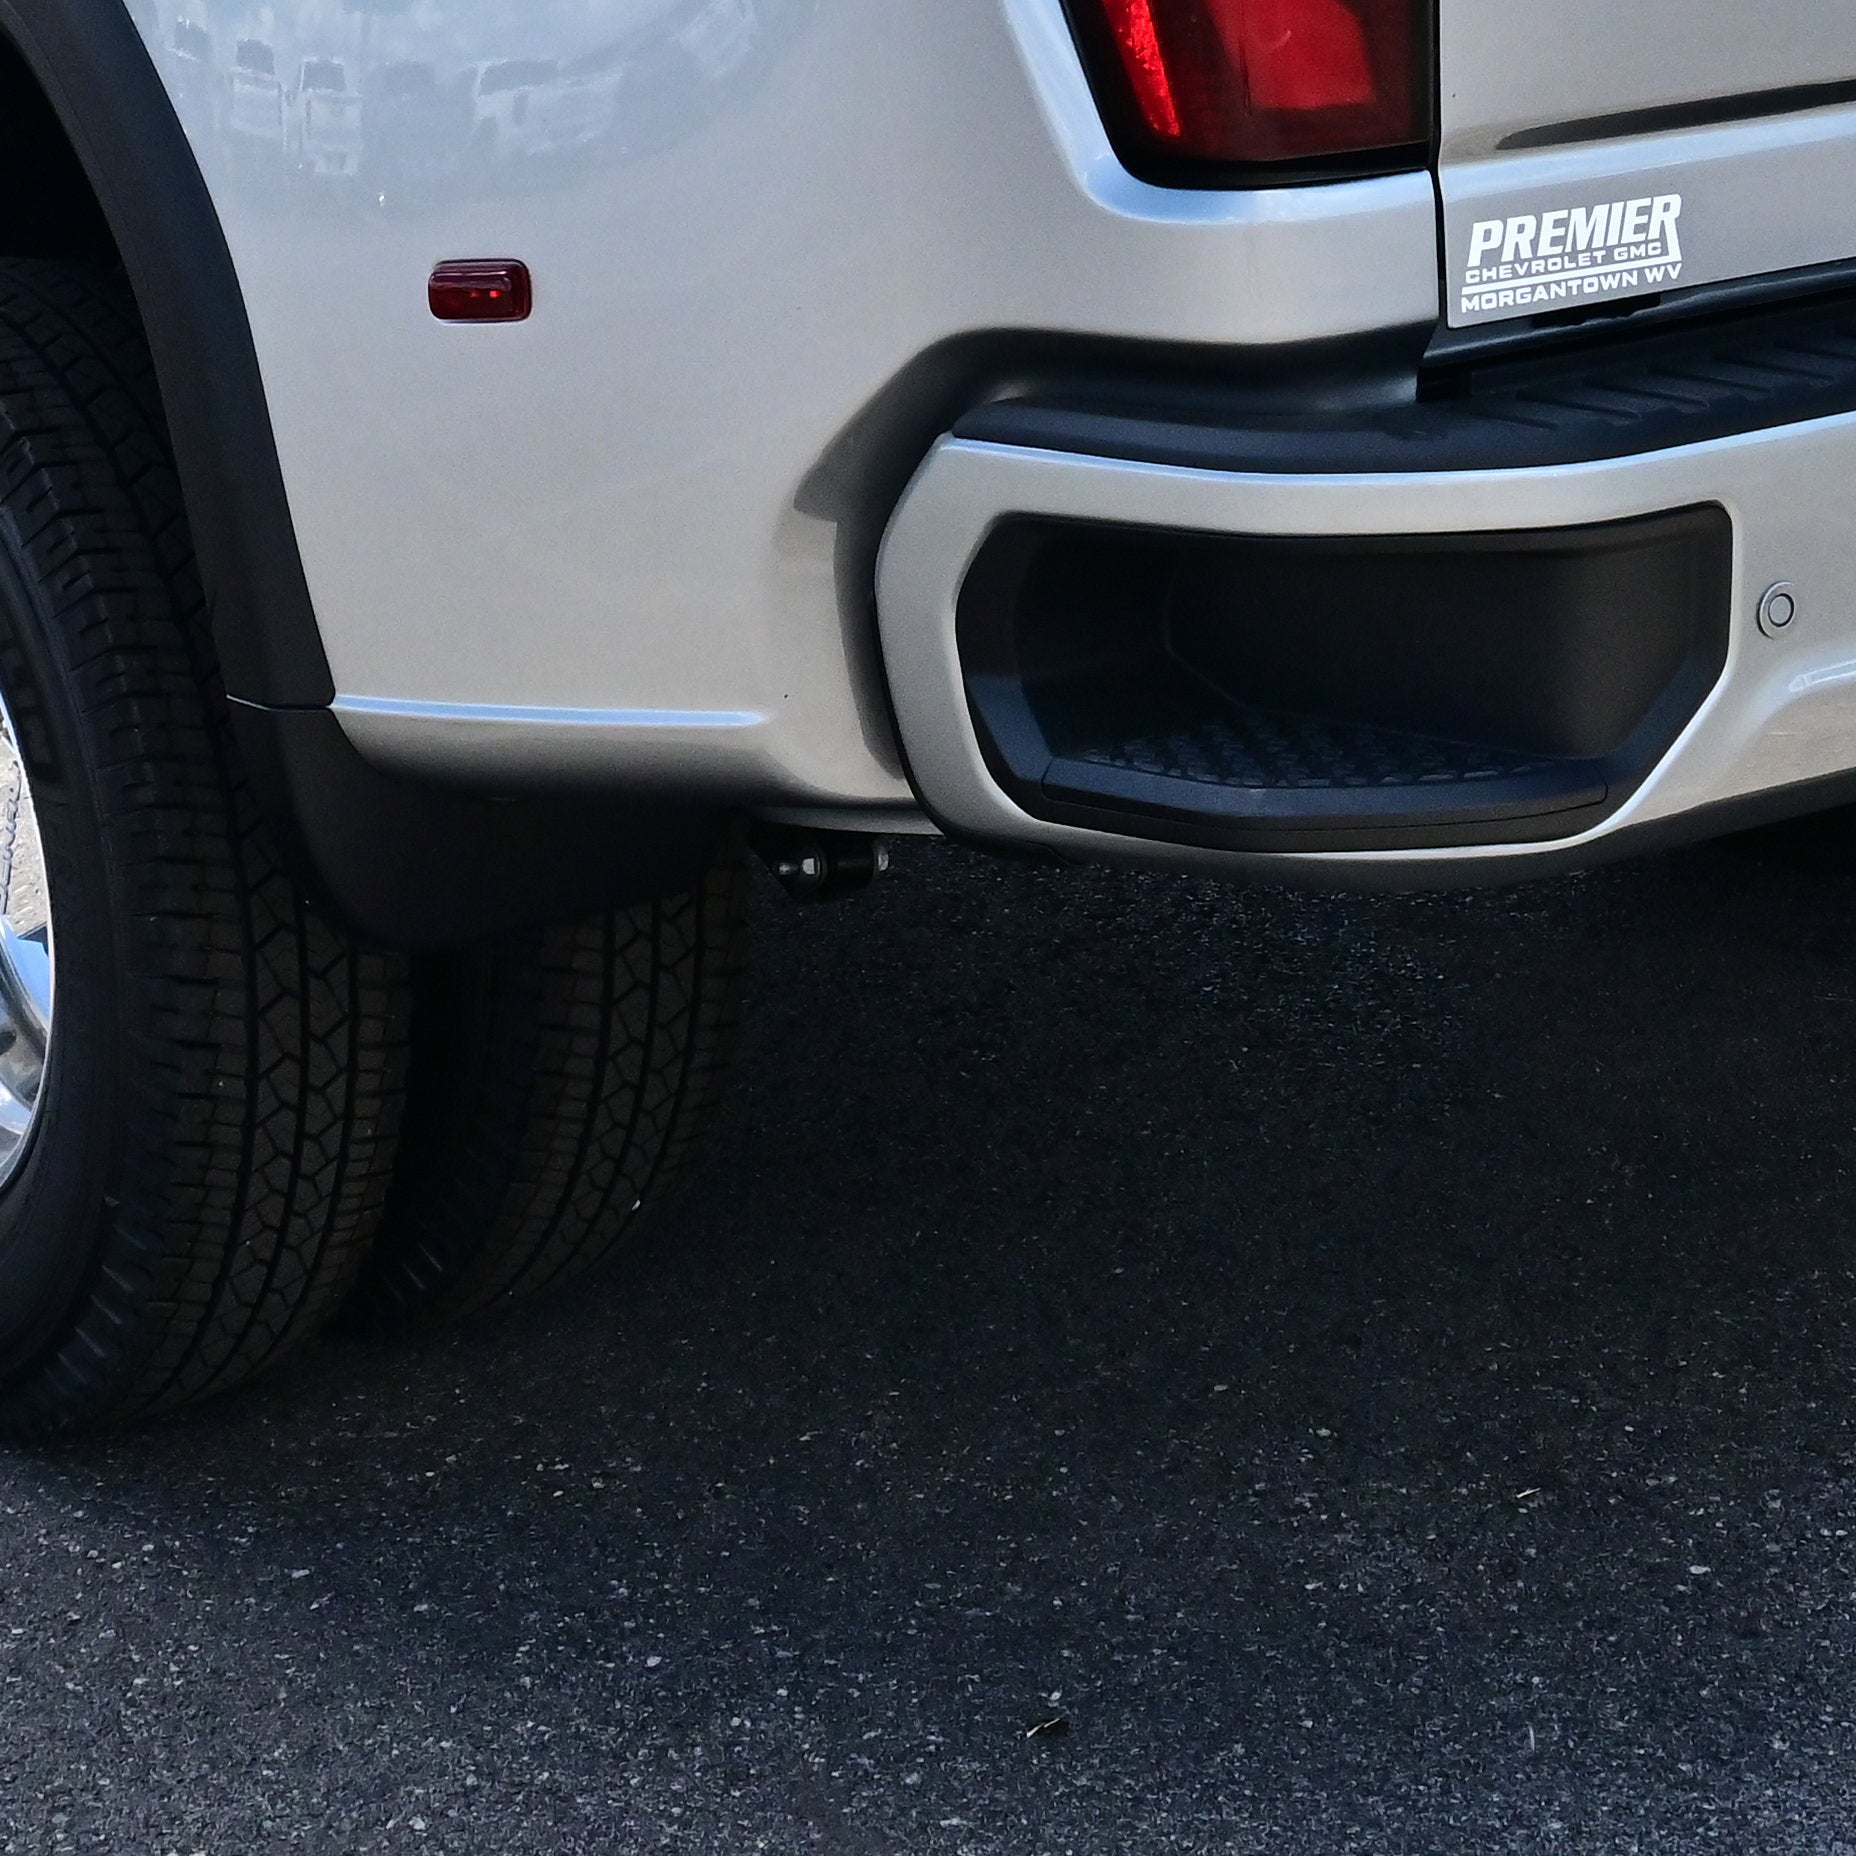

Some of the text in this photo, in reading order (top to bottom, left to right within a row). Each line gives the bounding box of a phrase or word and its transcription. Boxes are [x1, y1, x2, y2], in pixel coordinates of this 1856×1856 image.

[1466, 193, 1682, 267] PREMIER
[1465, 241, 1662, 284] CHEVROLET GMC
[1461, 263, 1683, 313] MORGANTOWN WV
